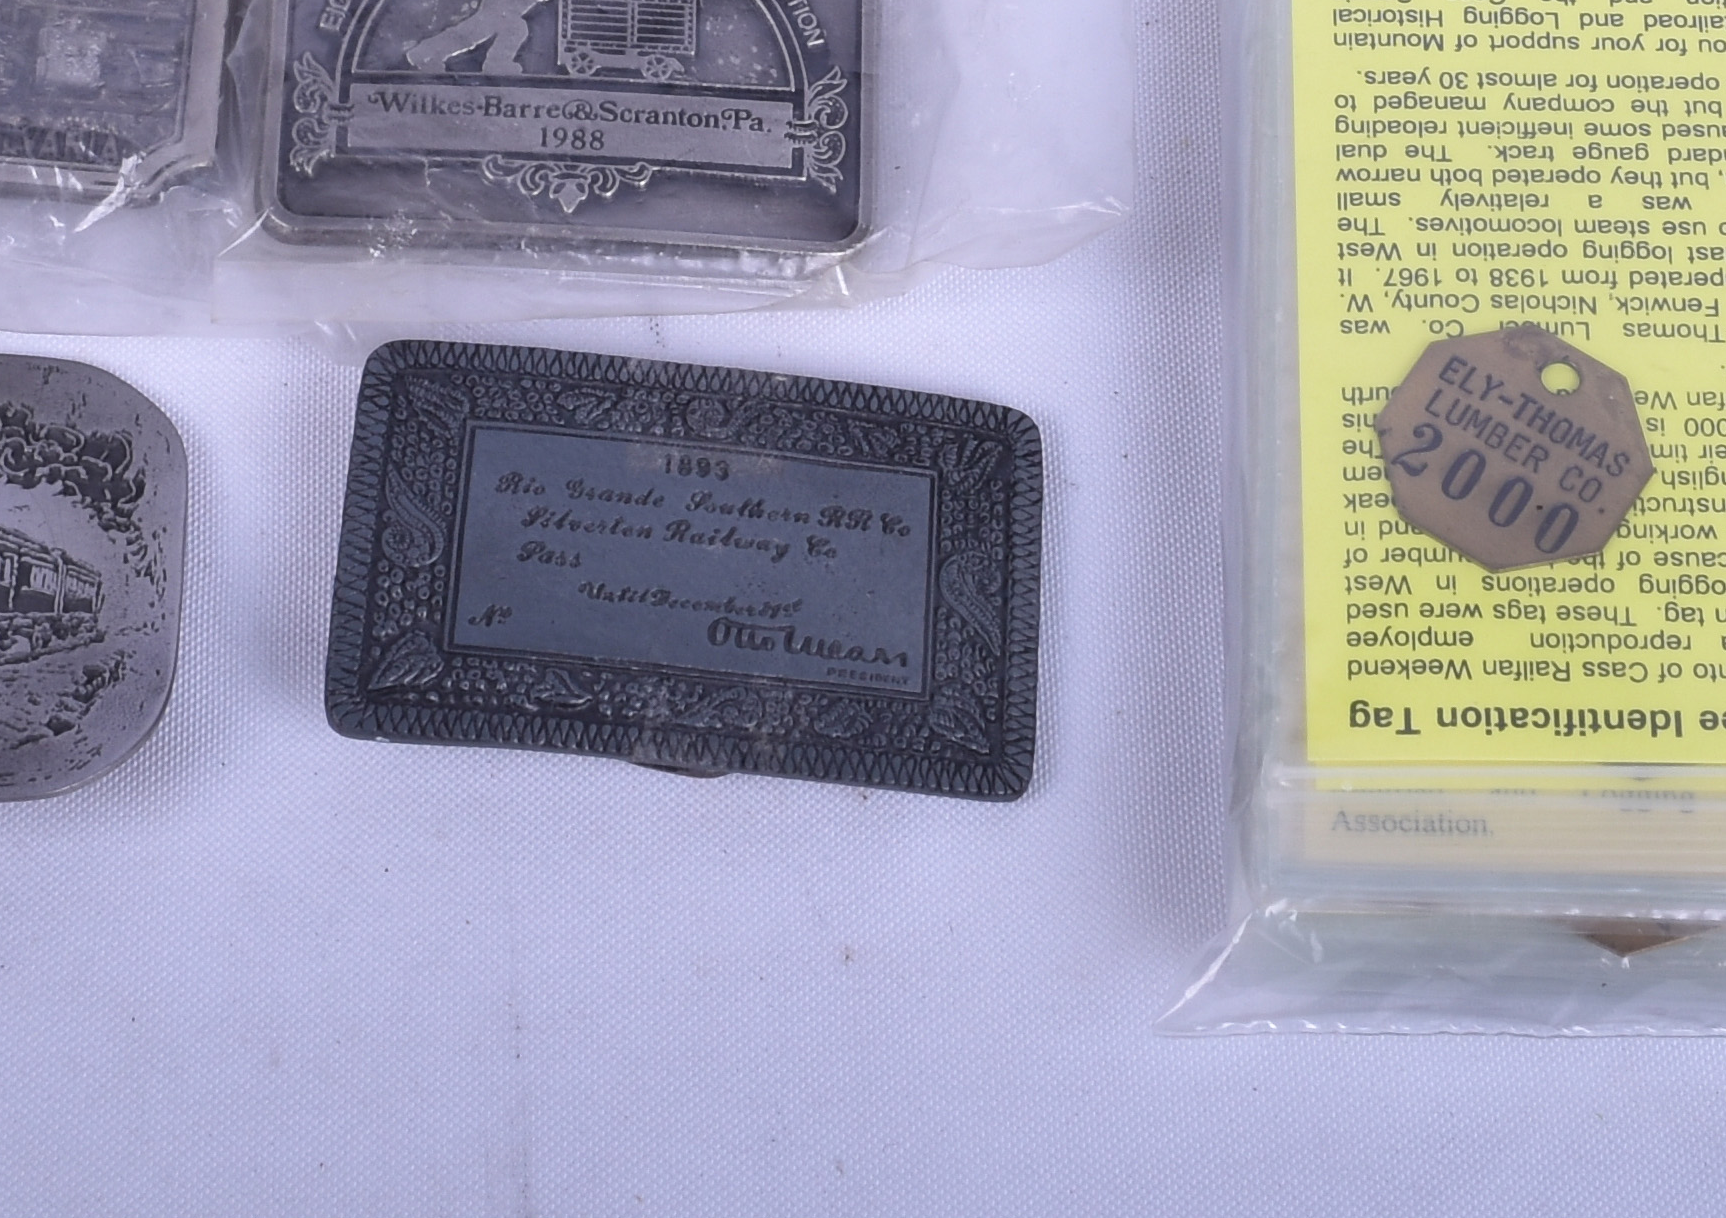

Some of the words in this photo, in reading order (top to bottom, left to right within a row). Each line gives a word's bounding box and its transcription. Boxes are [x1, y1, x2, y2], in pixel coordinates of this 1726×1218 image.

[1332, 31, 1444, 52] Mountain
[1453, 33, 1478, 53] of
[1487, 29, 1580, 52] support
[1589, 31, 1645, 52] your
[1654, 37, 1688, 57] for
[539, 125, 606, 153] 1988
[1339, 292, 1374, 313] W.
[1383, 287, 1480, 314] County,
[1489, 292, 1597, 316] Nicholas
[1607, 292, 1720, 318] Fenwick,
[1437, 354, 1631, 479] ELY-THOMAS
[1424, 388, 1551, 475] LUMBER
[662, 451, 732, 482] 1893
[493, 470, 547, 498] Rio
[564, 477, 666, 509] Grande
[683, 488, 811, 526] Southern
[1390, 422, 1581, 556] 2000
[519, 504, 654, 541] Silverton
[661, 518, 790, 564] Railway
[516, 539, 584, 570] Pass
[1346, 657, 1473, 681] Weekend
[1481, 658, 1571, 683] Railfan
[1580, 660, 1649, 684] Cass
[1656, 661, 1683, 684] of
[1348, 698, 1422, 736] Tag
[1435, 705, 1683, 738] Identification
